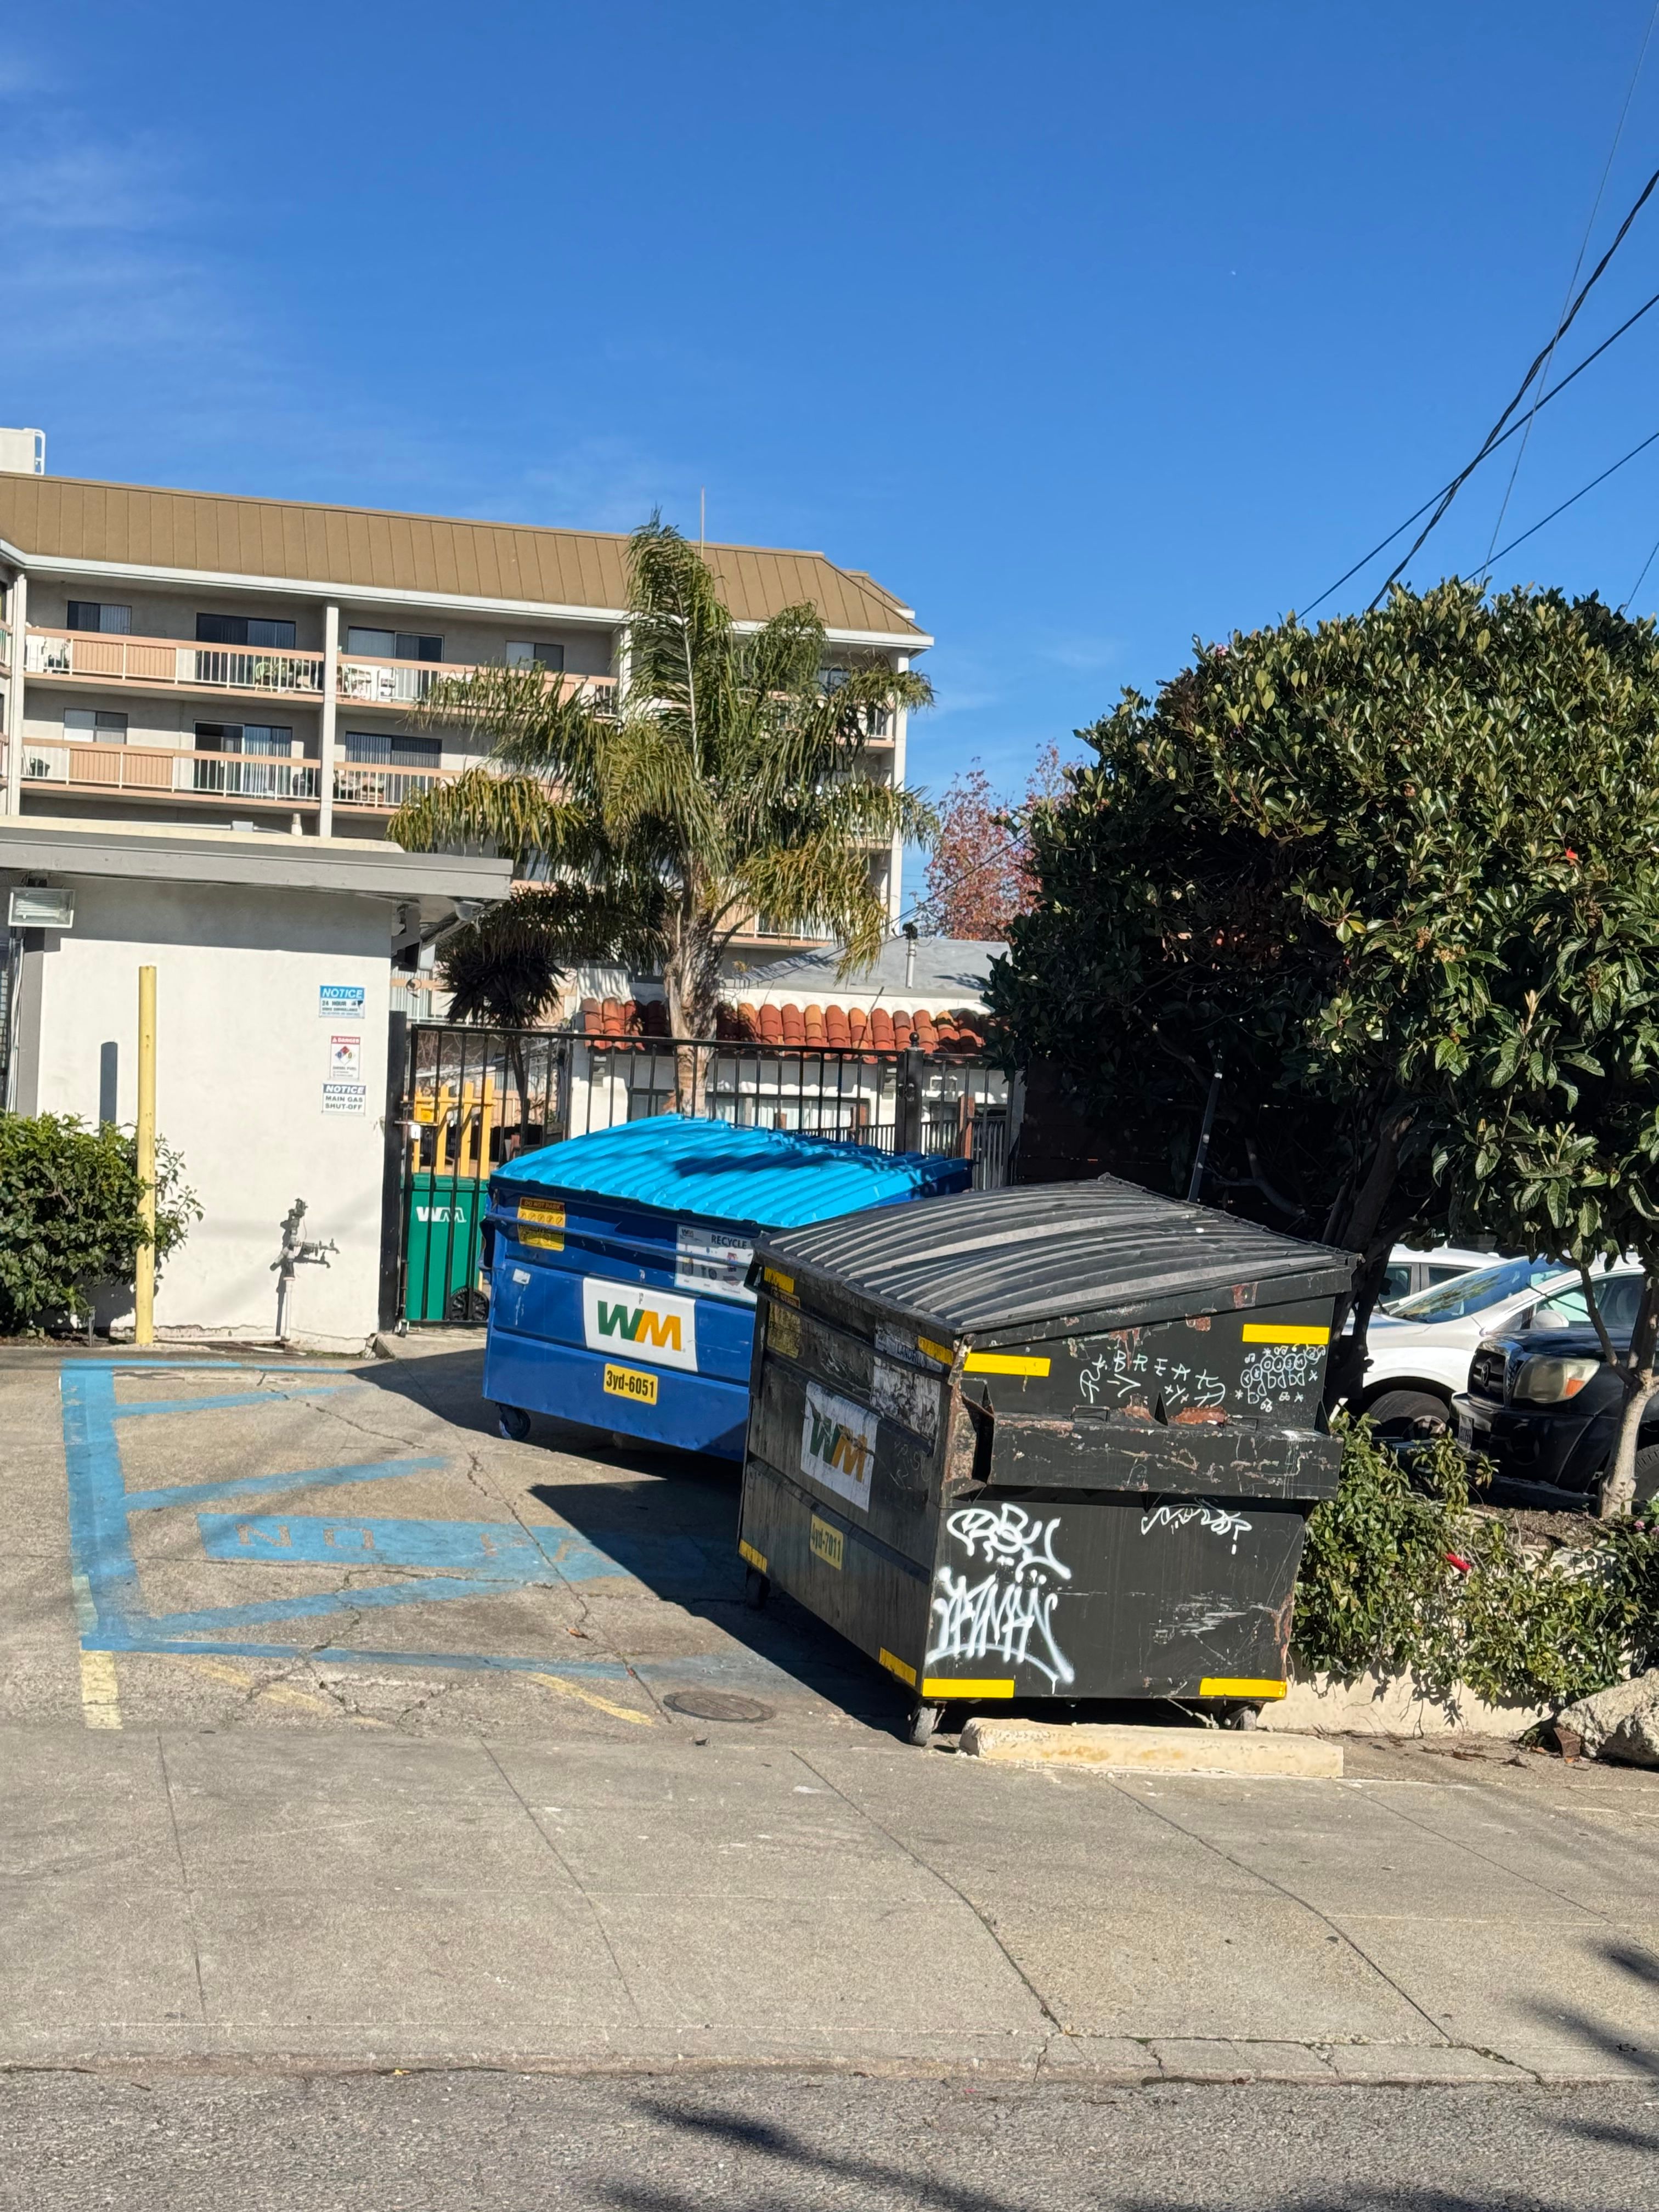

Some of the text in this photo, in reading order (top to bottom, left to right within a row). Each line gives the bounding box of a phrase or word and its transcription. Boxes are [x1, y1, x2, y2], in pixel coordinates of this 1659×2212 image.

[323, 988, 363, 998] NOTICE
[325, 1085, 364, 1094] NOTICE
[416, 1206, 466, 1223] WM
[711, 1234, 747, 1249] RECYCLE
[597, 1300, 681, 1352] WM
[606, 1370, 654, 1398] 3yd-6051
[809, 1414, 868, 1483] WM
[234, 1523, 376, 1550] NO
[812, 1522, 841, 1562] 4yd-7011
